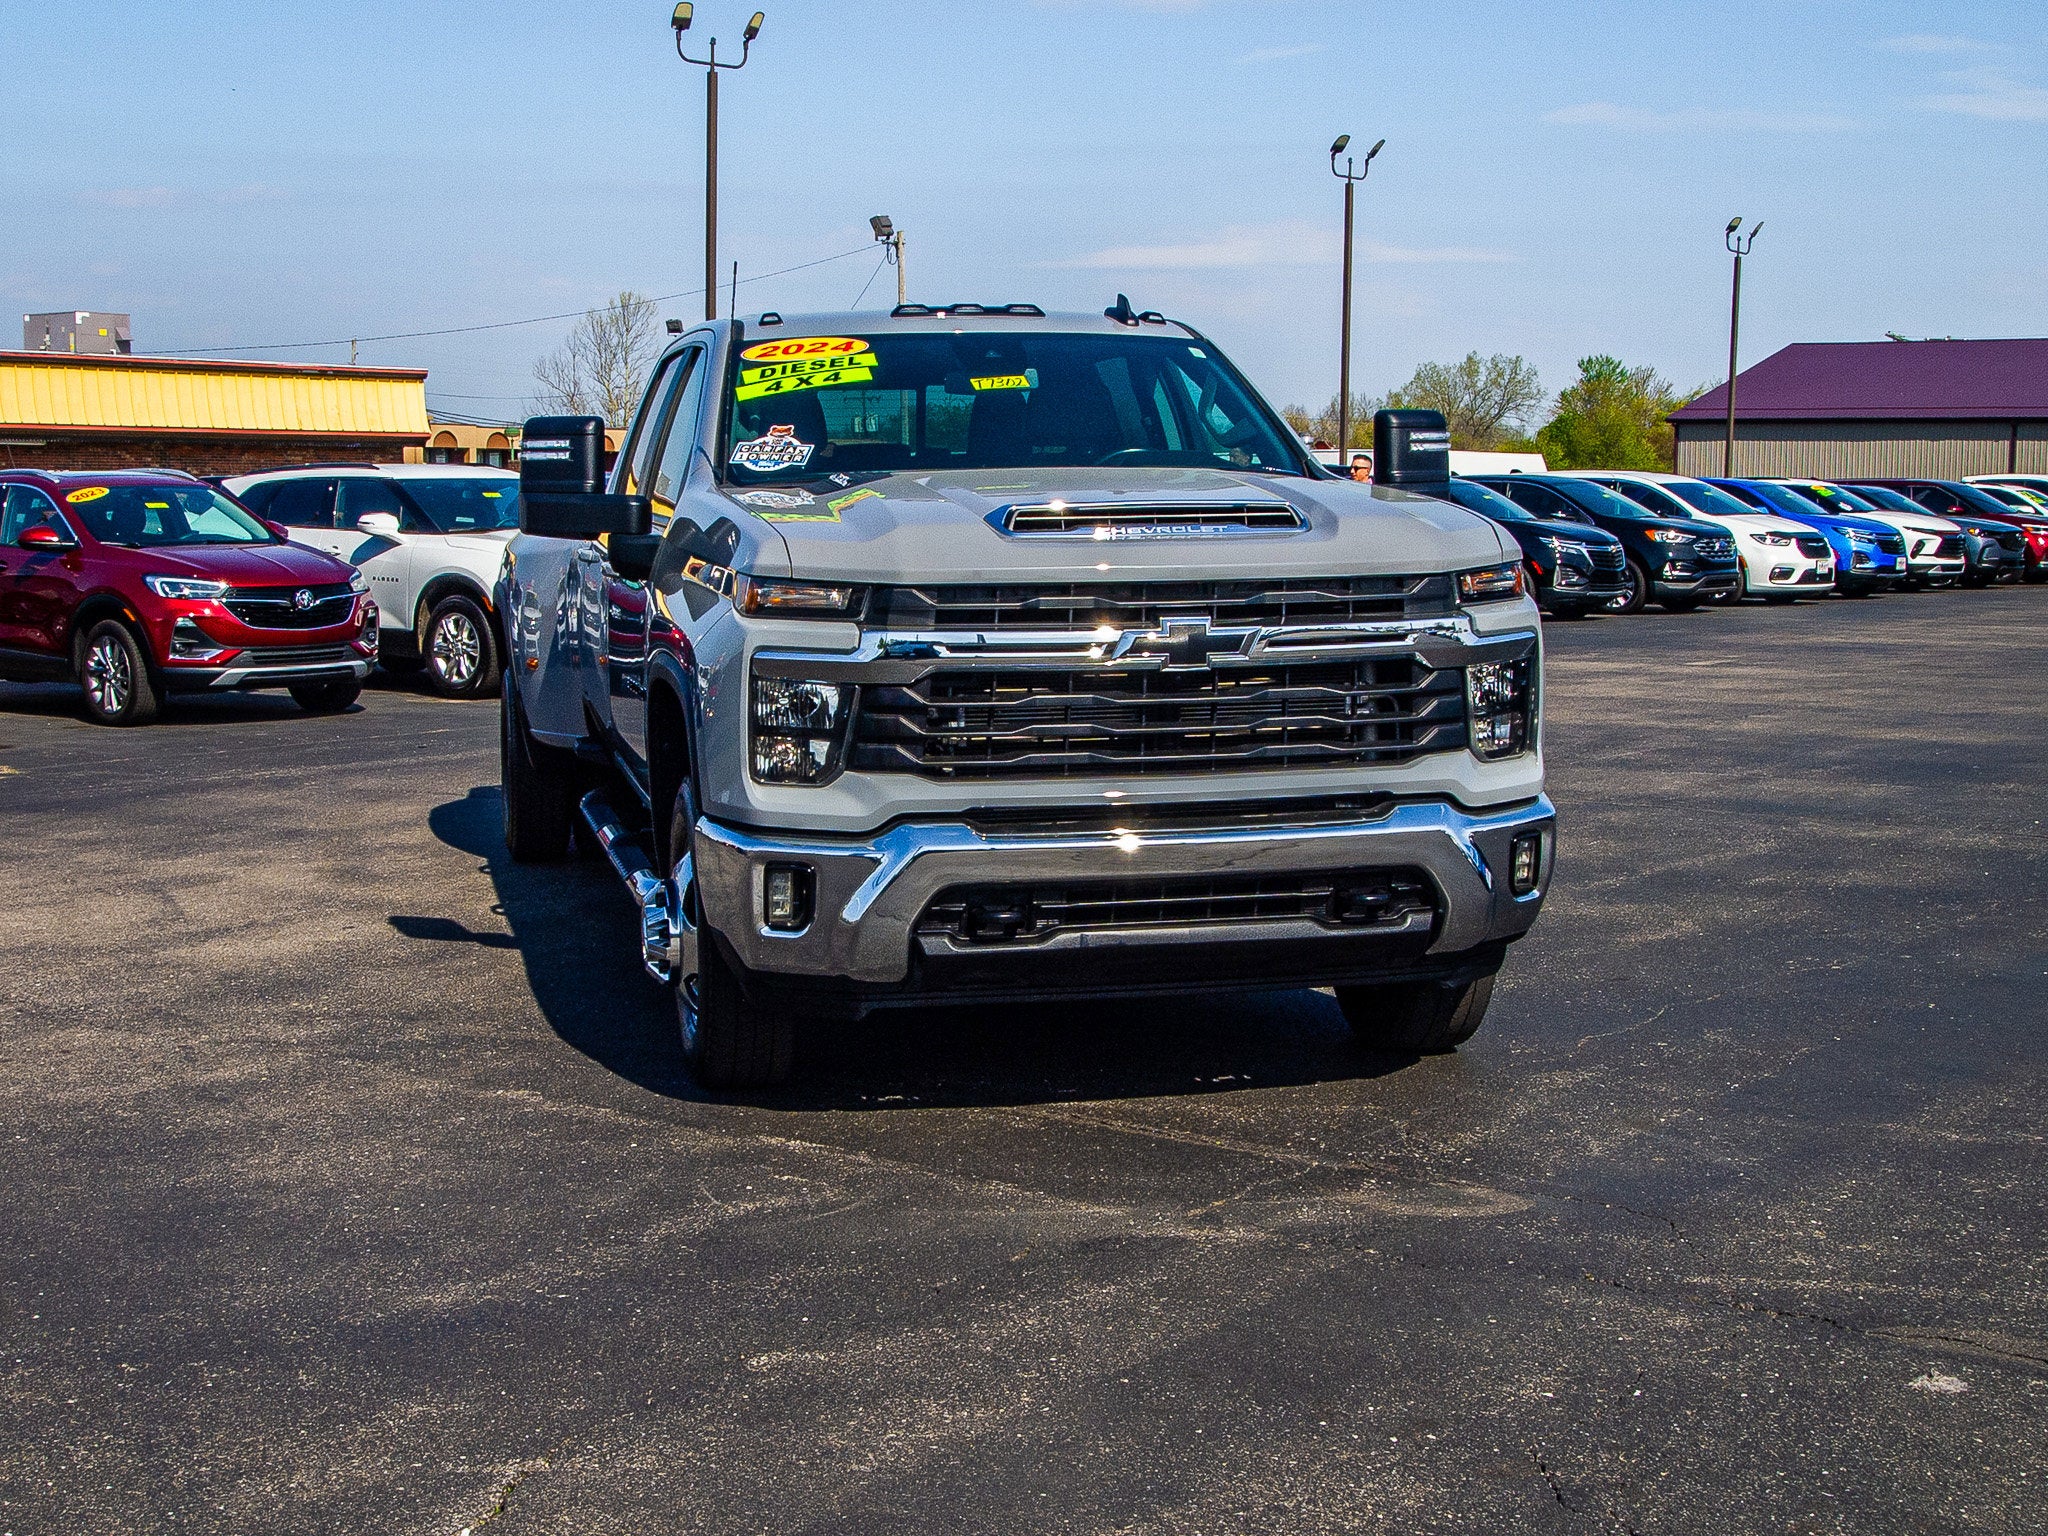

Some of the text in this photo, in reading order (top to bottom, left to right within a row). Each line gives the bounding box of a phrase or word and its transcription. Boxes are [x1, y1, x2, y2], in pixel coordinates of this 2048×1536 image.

[756, 341, 855, 358] 2024
[759, 357, 861, 379] DIESEL
[740, 445, 806, 455] CARFAX
[72, 488, 105, 502] 2023
[1095, 525, 1227, 535] CHEVROLET
